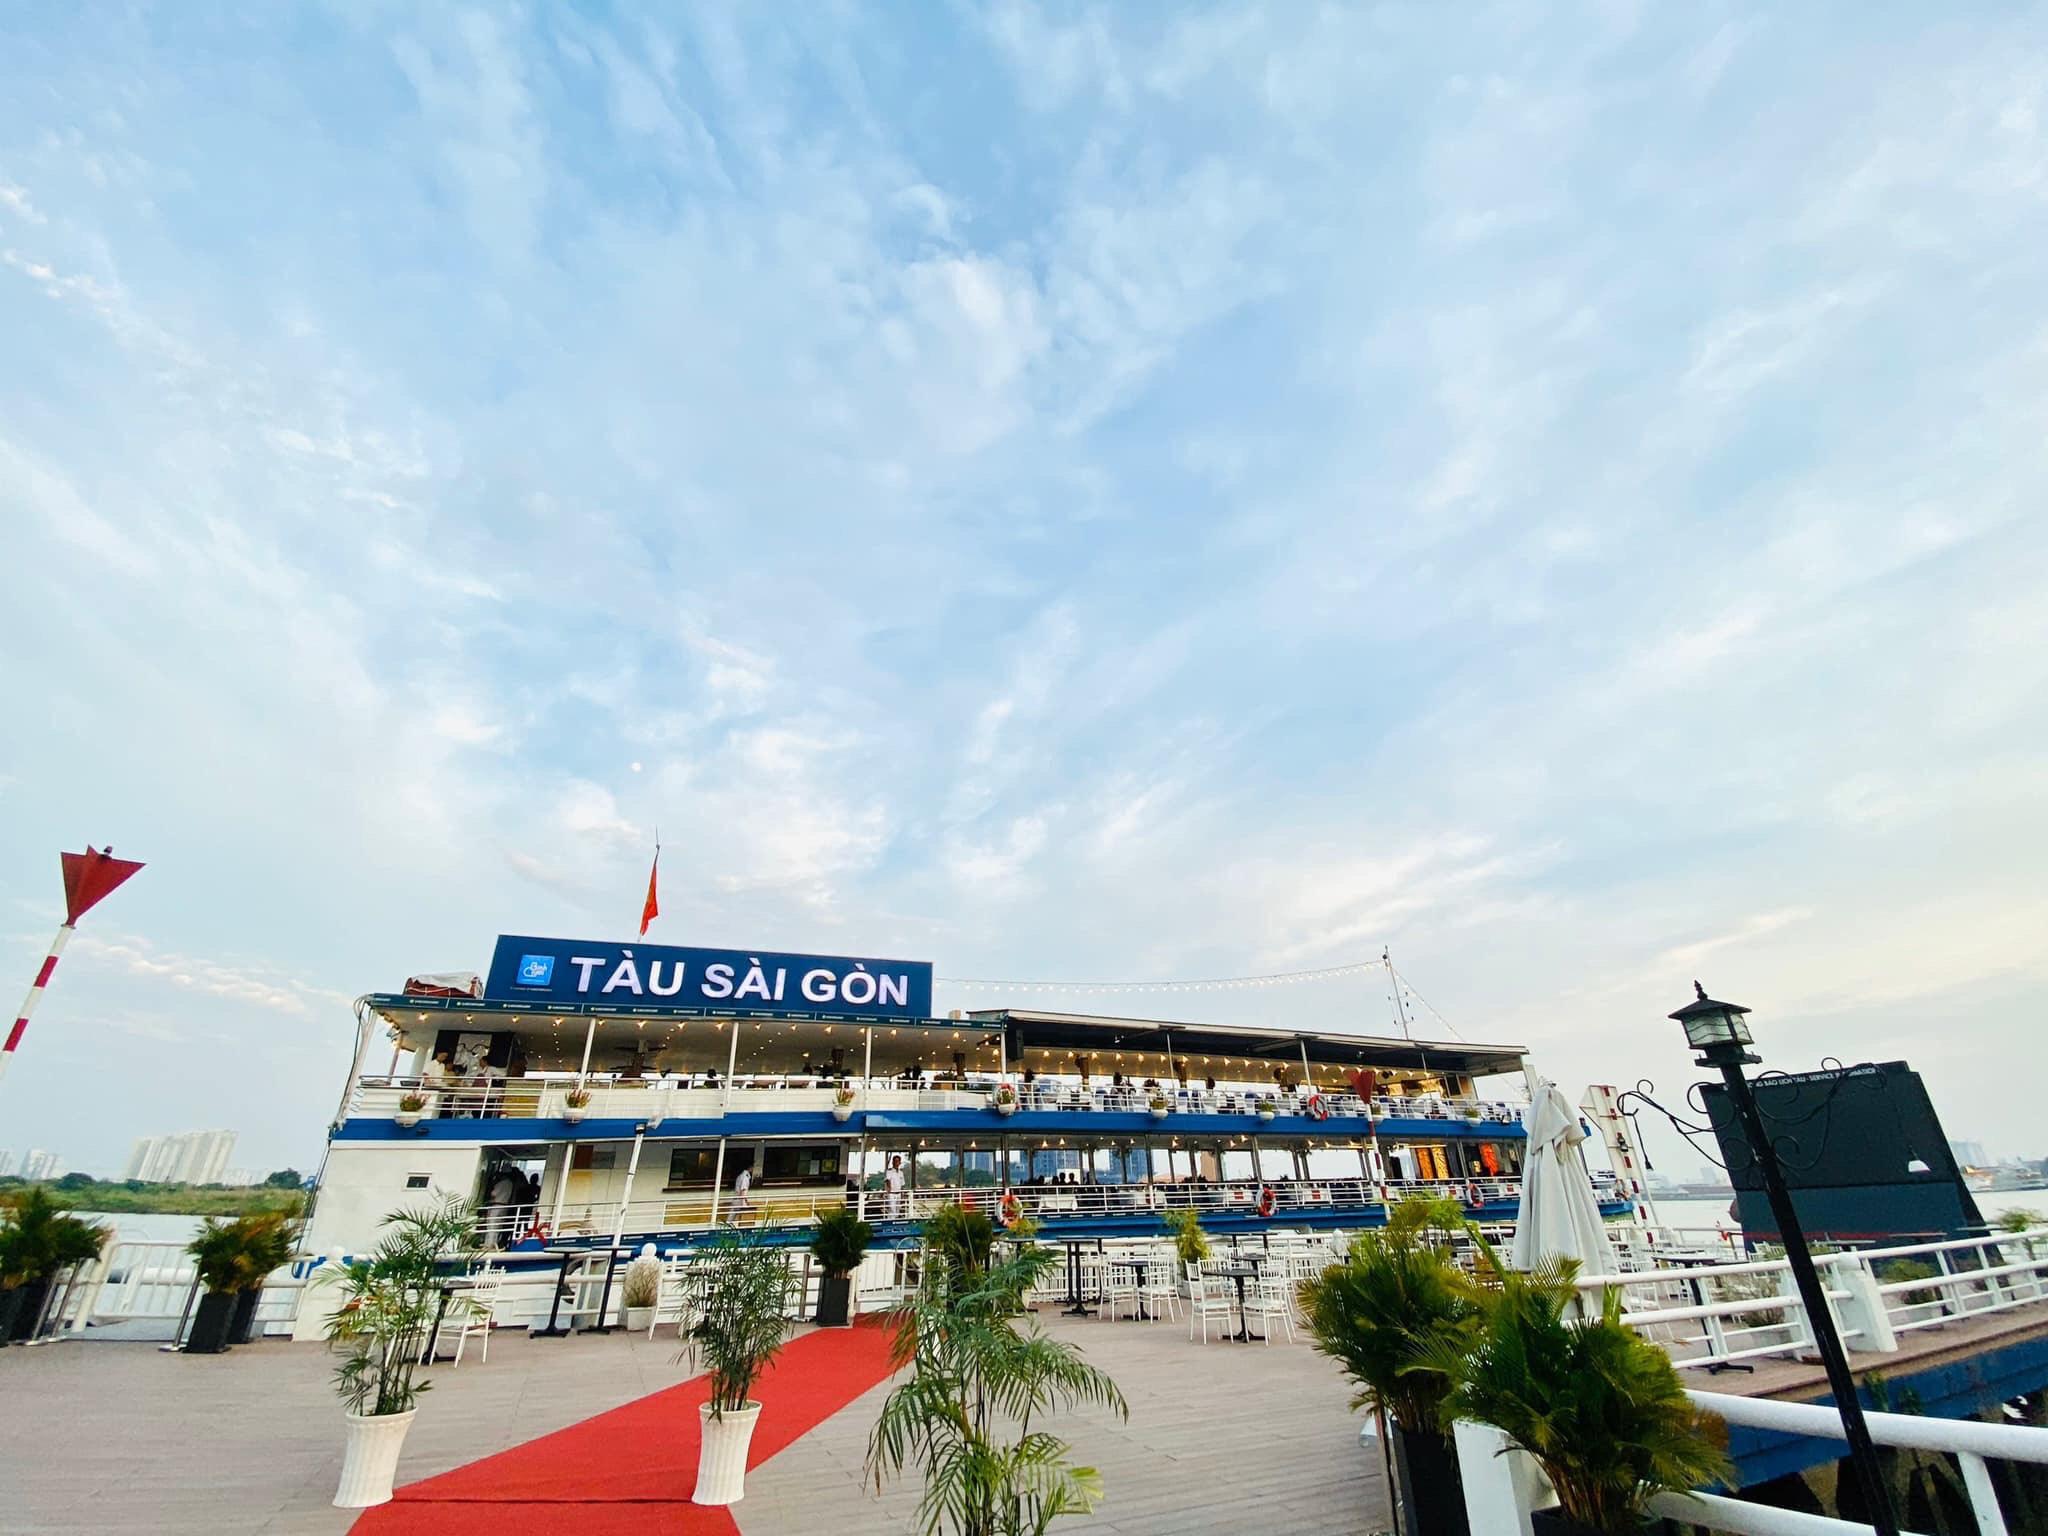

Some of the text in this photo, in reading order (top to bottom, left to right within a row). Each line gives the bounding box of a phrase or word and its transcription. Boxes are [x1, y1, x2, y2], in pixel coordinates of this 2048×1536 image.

[570, 950, 908, 1006] TÀU SÀI GÒN
